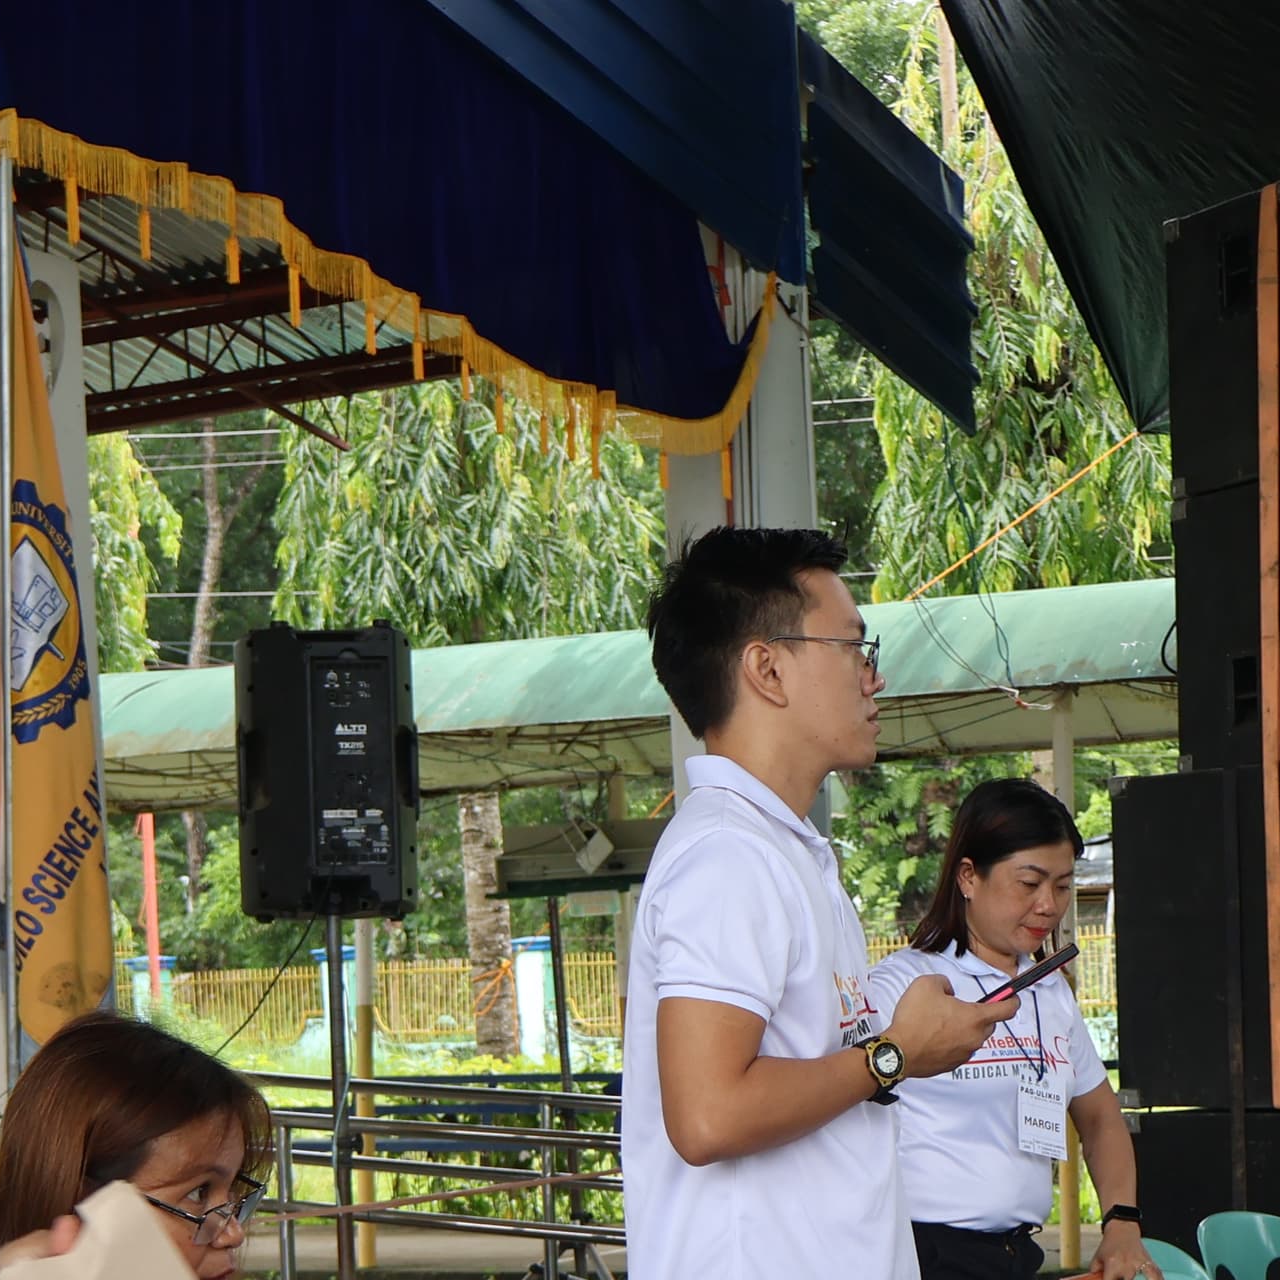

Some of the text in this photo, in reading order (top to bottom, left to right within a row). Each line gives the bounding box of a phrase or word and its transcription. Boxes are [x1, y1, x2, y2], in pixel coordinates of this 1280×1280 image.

[22, 805, 99, 916] SCIENCE
[952, 1065, 1009, 1081] MEDICAL
[1024, 1115, 1061, 1133] MARGIE
